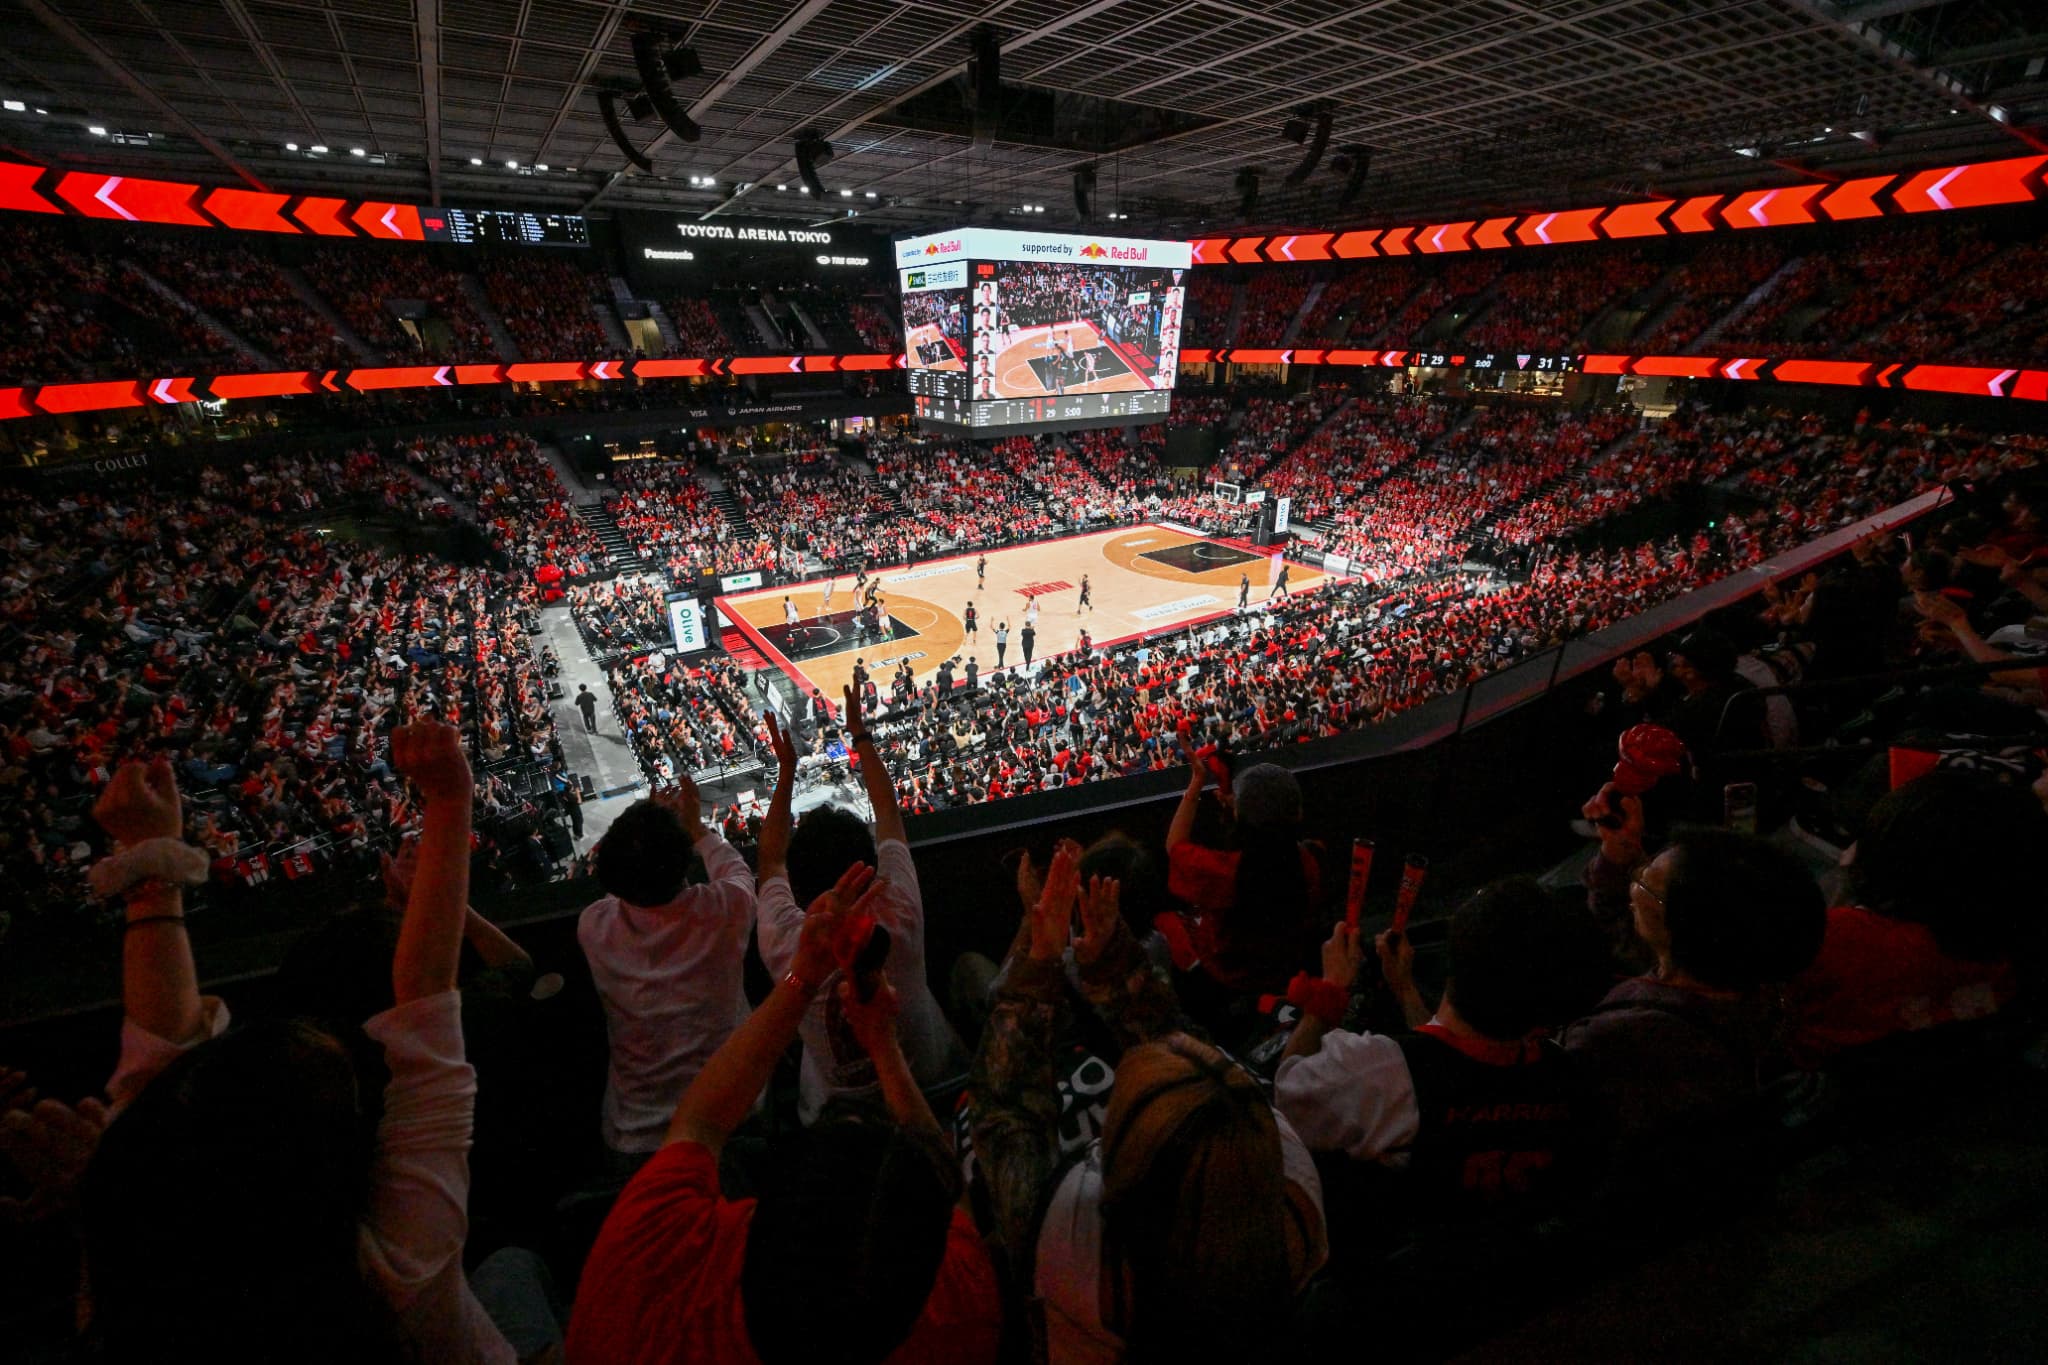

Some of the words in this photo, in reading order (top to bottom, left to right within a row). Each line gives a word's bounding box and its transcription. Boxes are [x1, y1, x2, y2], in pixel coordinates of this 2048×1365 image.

[677, 223, 735, 239] TOYOTA
[738, 228, 787, 241] ARENA
[788, 231, 832, 245] TOKYO
[644, 248, 694, 261] Panasonic
[1022, 243, 1063, 256] supported
[1063, 244, 1073, 257] by
[1111, 246, 1131, 260] Red
[1130, 247, 1148, 261] Bull
[1430, 355, 1445, 366] 29
[1474, 359, 1492, 368] 5:00
[1537, 357, 1553, 369] 31
[689, 409, 708, 418] VISA
[738, 407, 765, 415] JAPAN
[766, 404, 803, 412] AIRLINES
[1046, 408, 1057, 418] 29
[1064, 407, 1082, 417] 5:00
[1100, 405, 1110, 415] 31
[93, 453, 149, 473] COLLET
[679, 607, 696, 644] Olive
